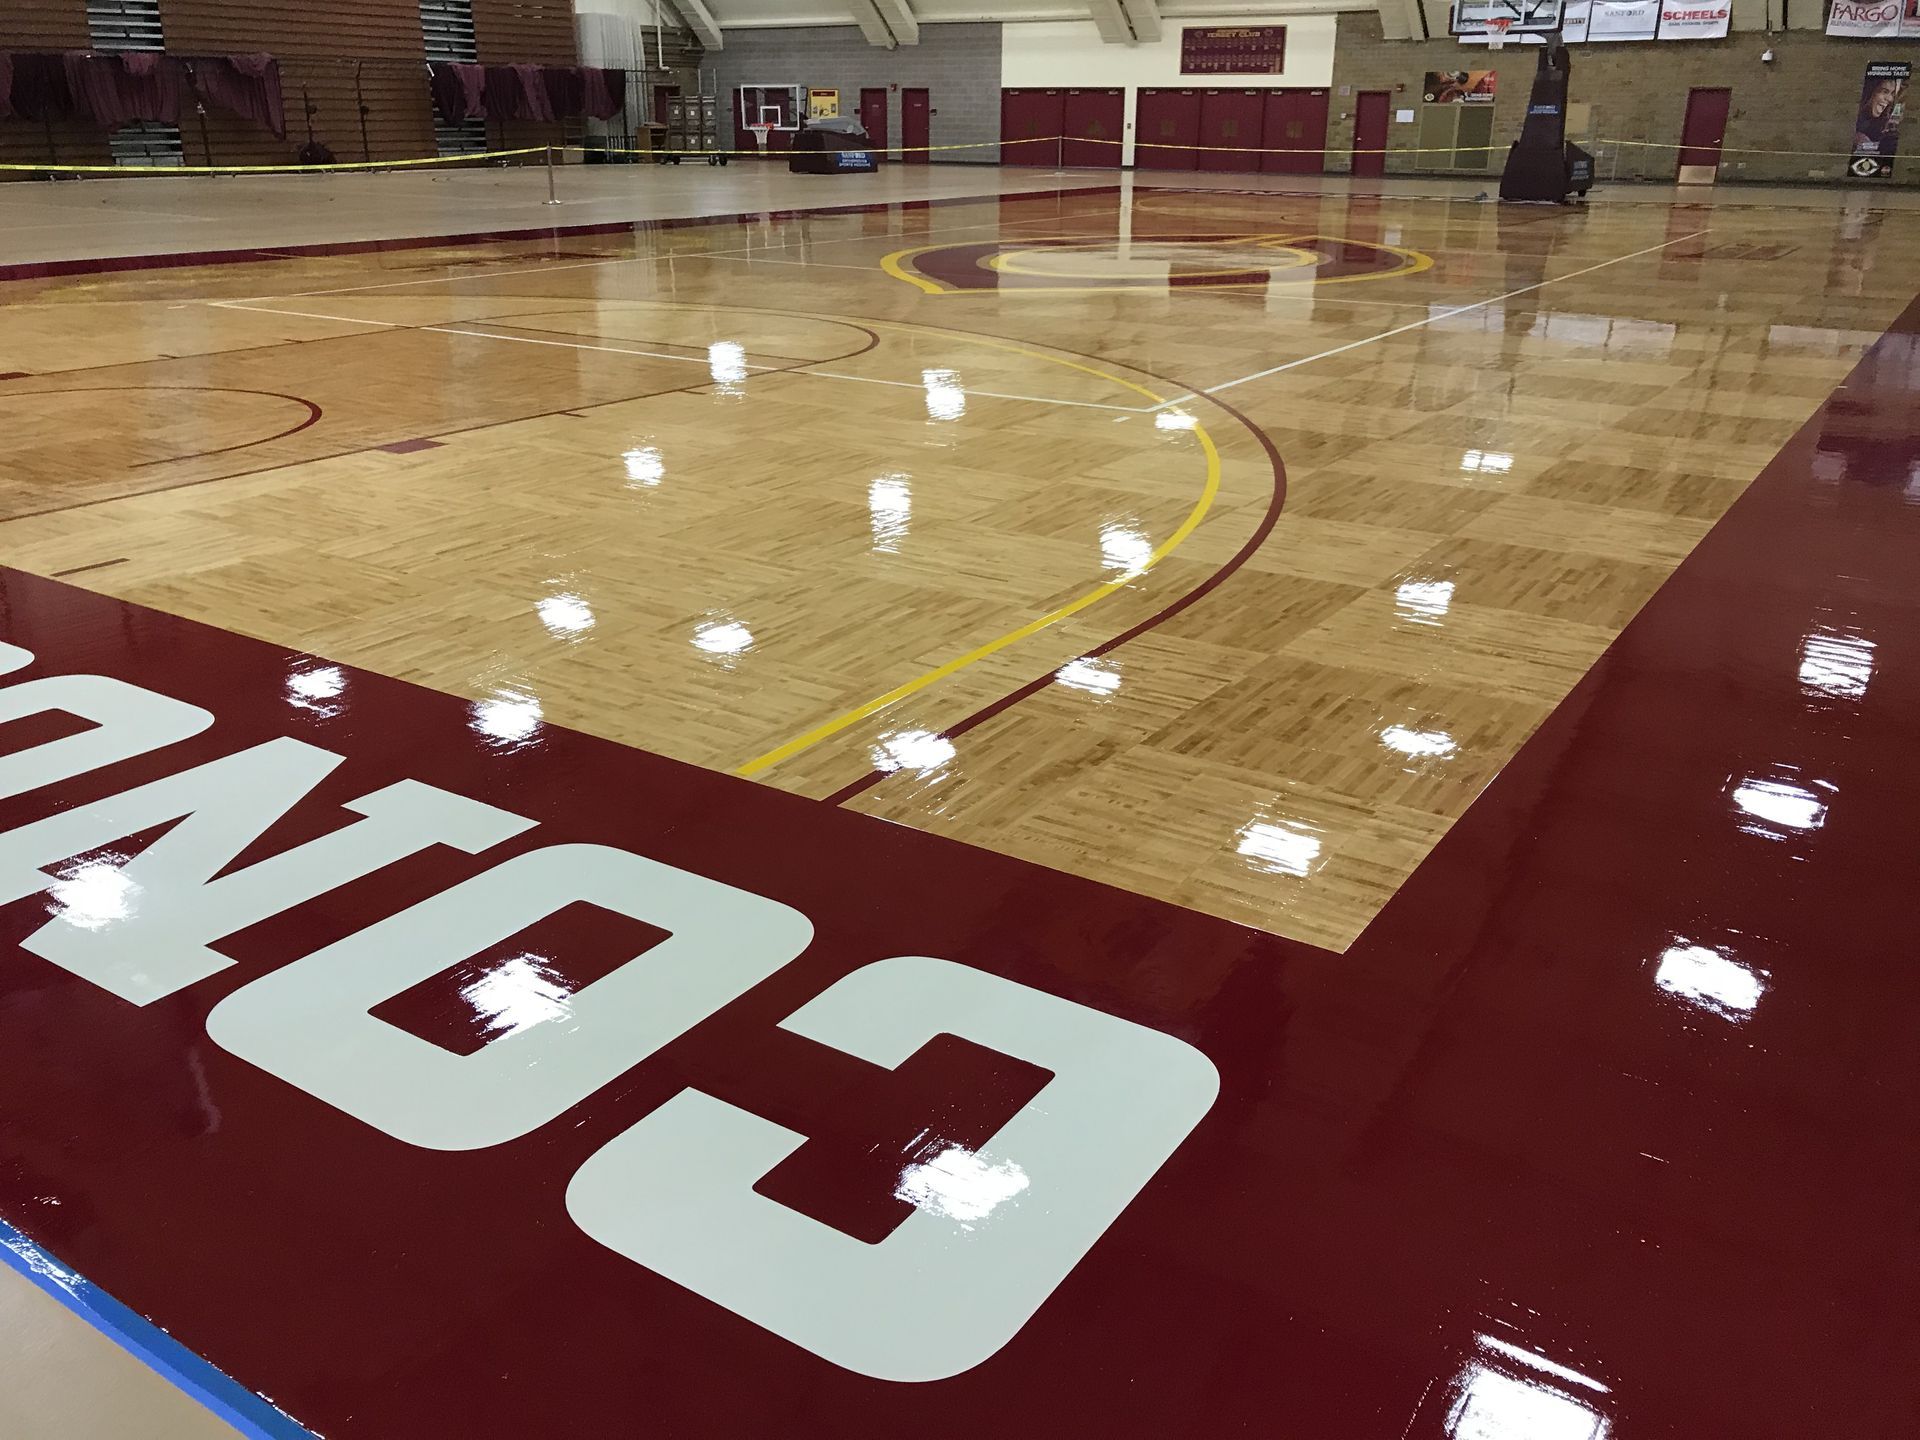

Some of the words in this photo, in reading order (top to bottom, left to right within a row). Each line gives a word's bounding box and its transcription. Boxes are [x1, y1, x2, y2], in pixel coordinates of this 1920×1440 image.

[1604, 9, 1645, 17] SANFORD
[1662, 8, 1728, 21] SCHEELS
[1831, 2, 1898, 22] FARGO
[0, 640, 1221, 1382] CON
